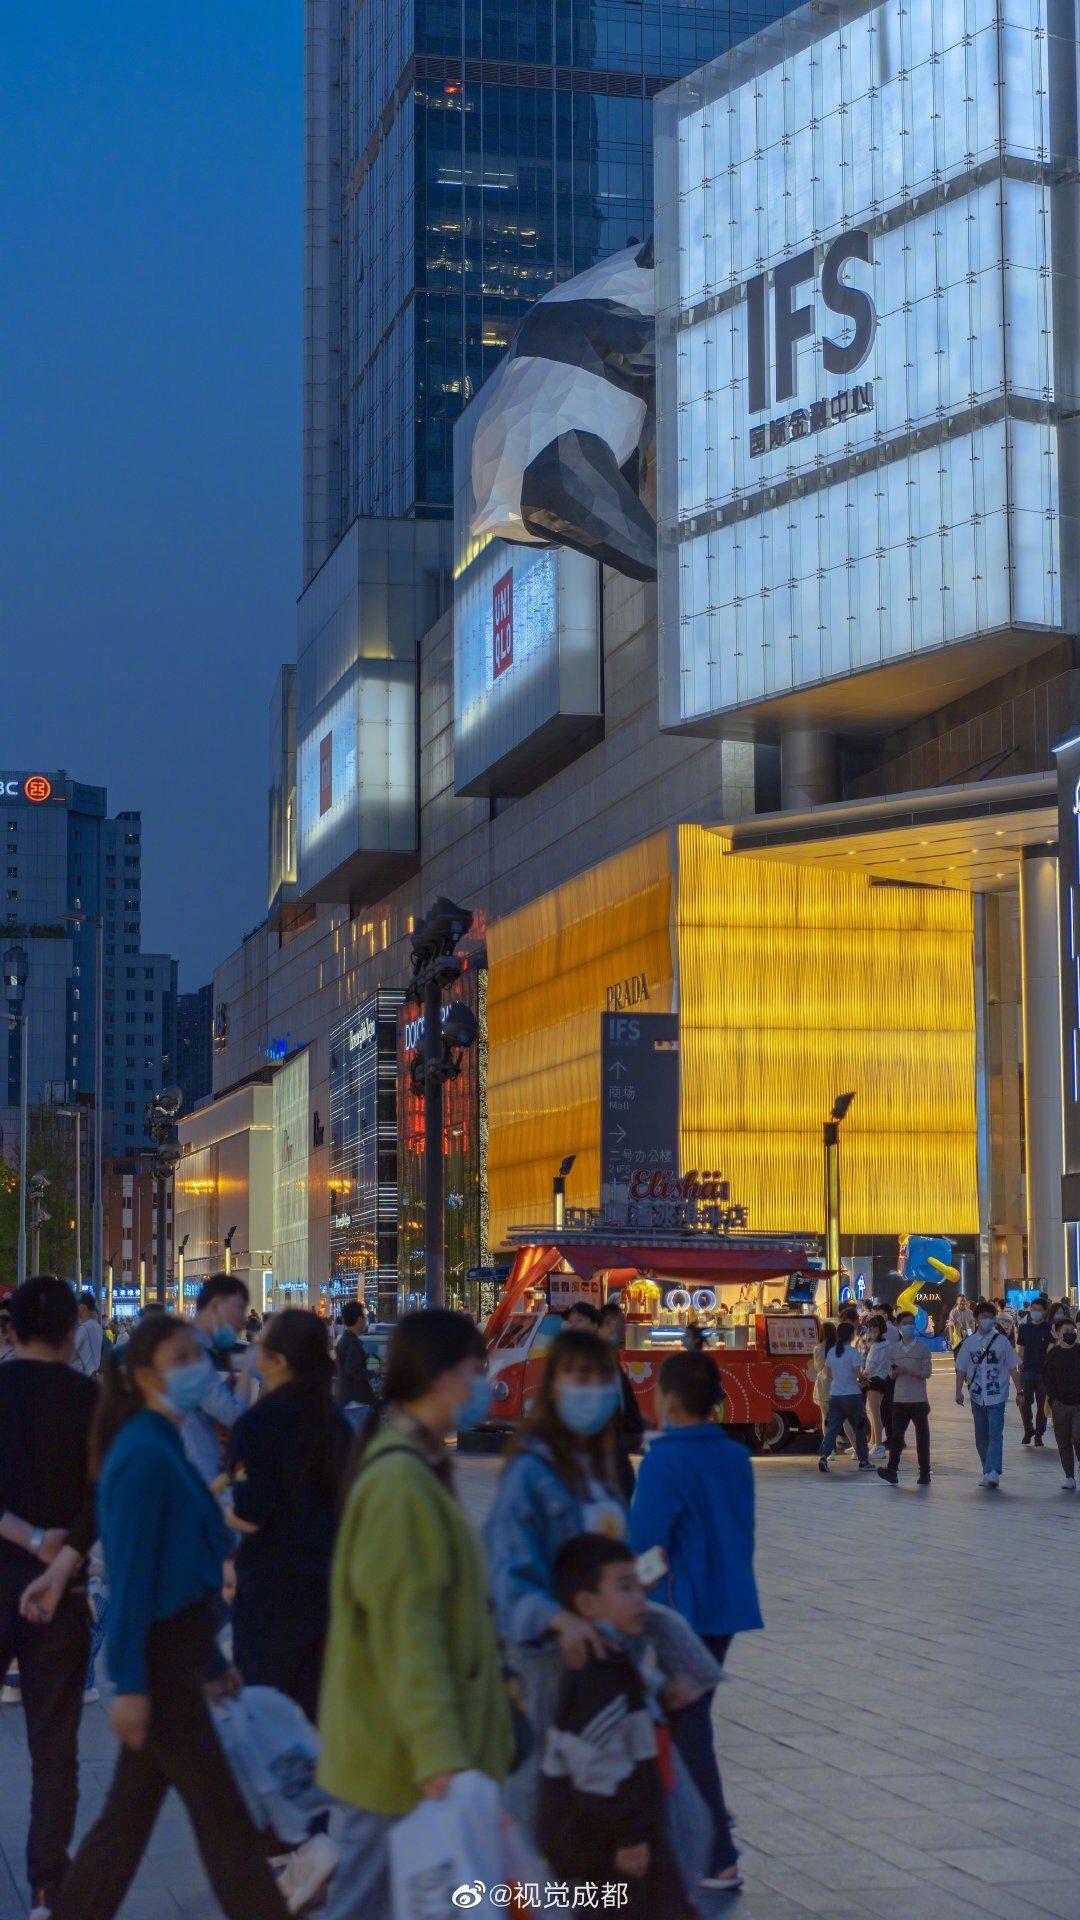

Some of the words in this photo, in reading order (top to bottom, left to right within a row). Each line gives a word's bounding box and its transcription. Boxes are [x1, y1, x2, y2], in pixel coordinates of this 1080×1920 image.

[747, 230, 877, 415] IFS
[494, 583, 511, 626] UNI
[494, 624, 512, 670] QLO
[607, 973, 650, 1012] PRADA
[609, 1019, 640, 1040] IFS
[608, 1085, 635, 1100] 商场
[609, 1101, 629, 1110] Mall
[609, 1149, 673, 1163] 二号办公楼
[609, 1164, 615, 1173] 2
[616, 1164, 631, 1173] IFS
